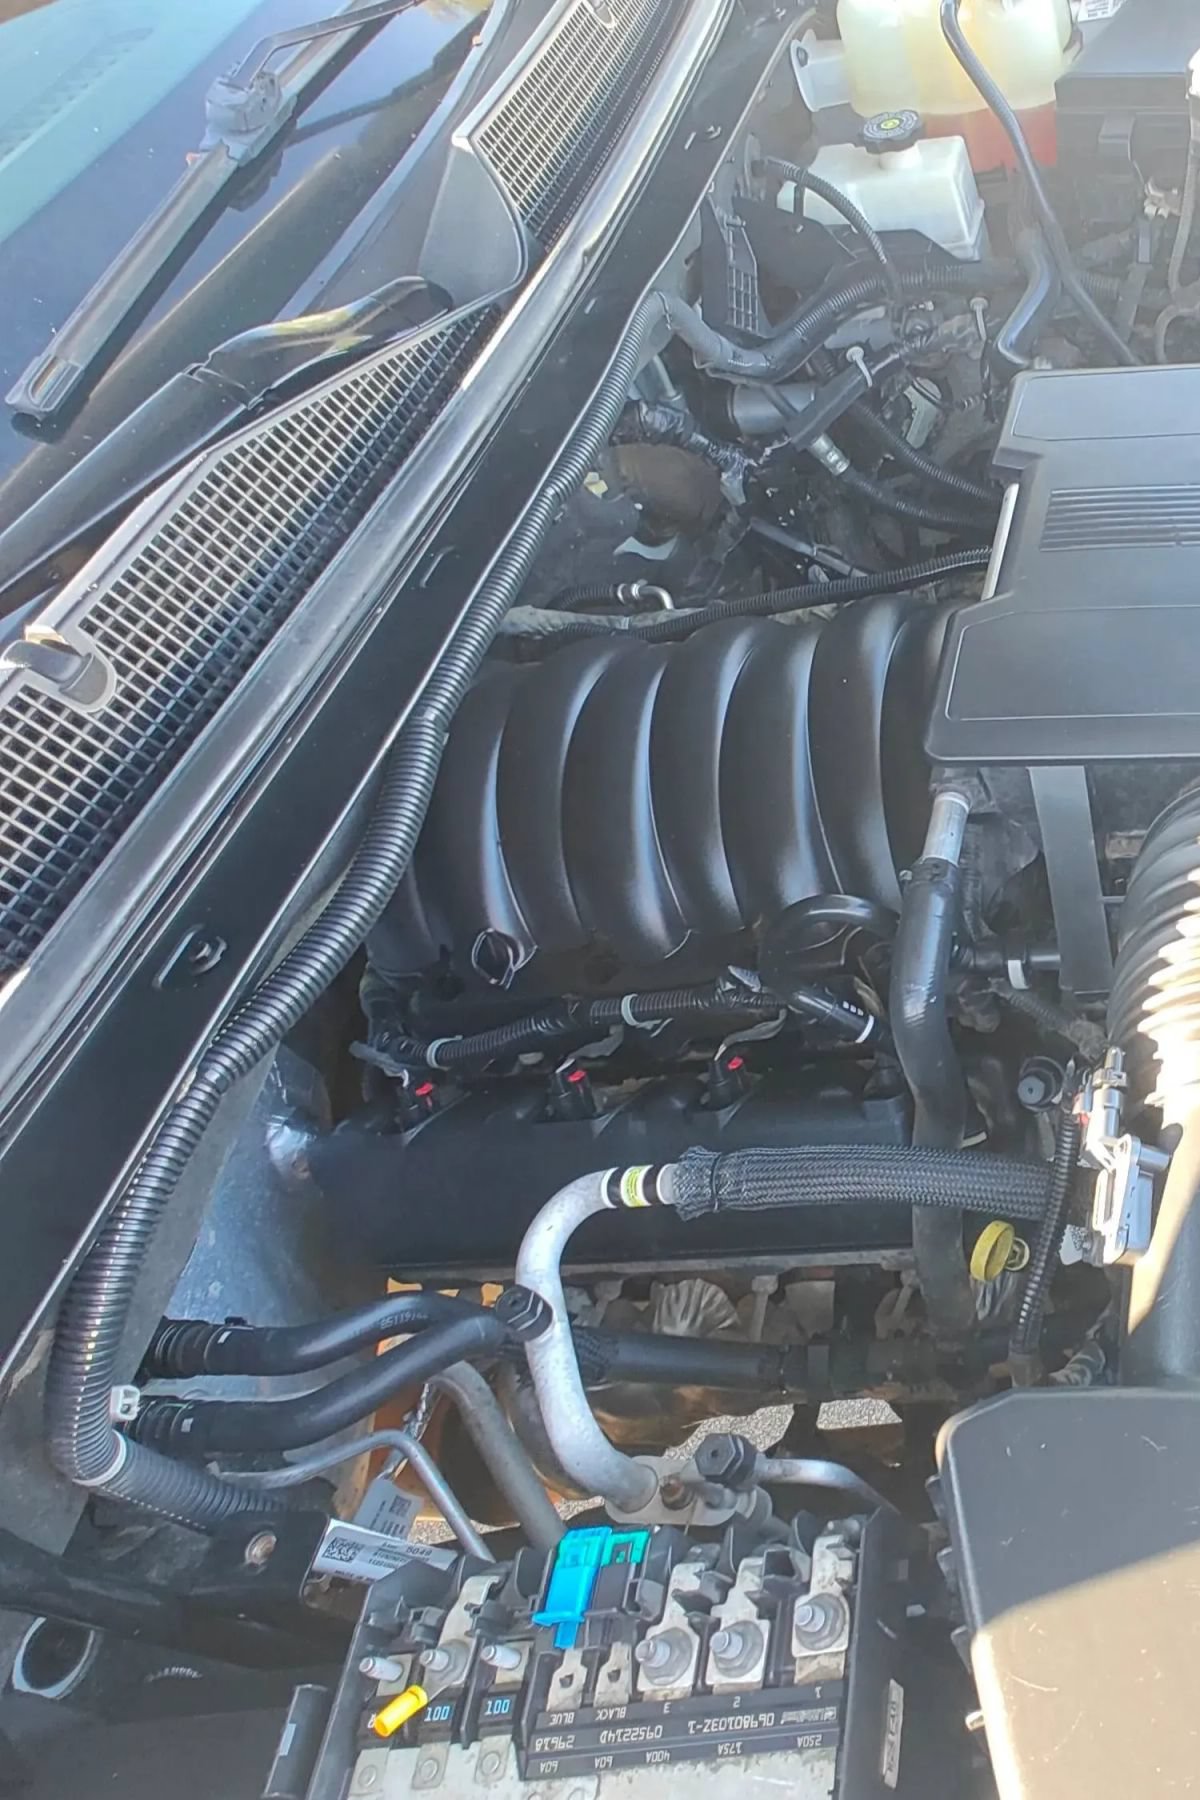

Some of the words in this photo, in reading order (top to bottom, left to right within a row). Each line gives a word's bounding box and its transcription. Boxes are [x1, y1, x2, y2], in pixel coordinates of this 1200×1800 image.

[814, 1686, 822, 1698] 1
[484, 1699, 510, 1715] 100
[663, 1702, 671, 1714] 3
[733, 1696, 741, 1708] 2
[424, 1705, 450, 1722] 100
[548, 1712, 575, 1725] BLUE
[595, 1707, 627, 1720] BLACK
[600, 1725, 663, 1743] 0952214D
[535, 1735, 575, 1752] 29618
[797, 1734, 822, 1748] 250A
[718, 1742, 743, 1755] 175A
[594, 1756, 613, 1768] 60A
[646, 1750, 671, 1763] 400A
[540, 1760, 559, 1773] 60A
